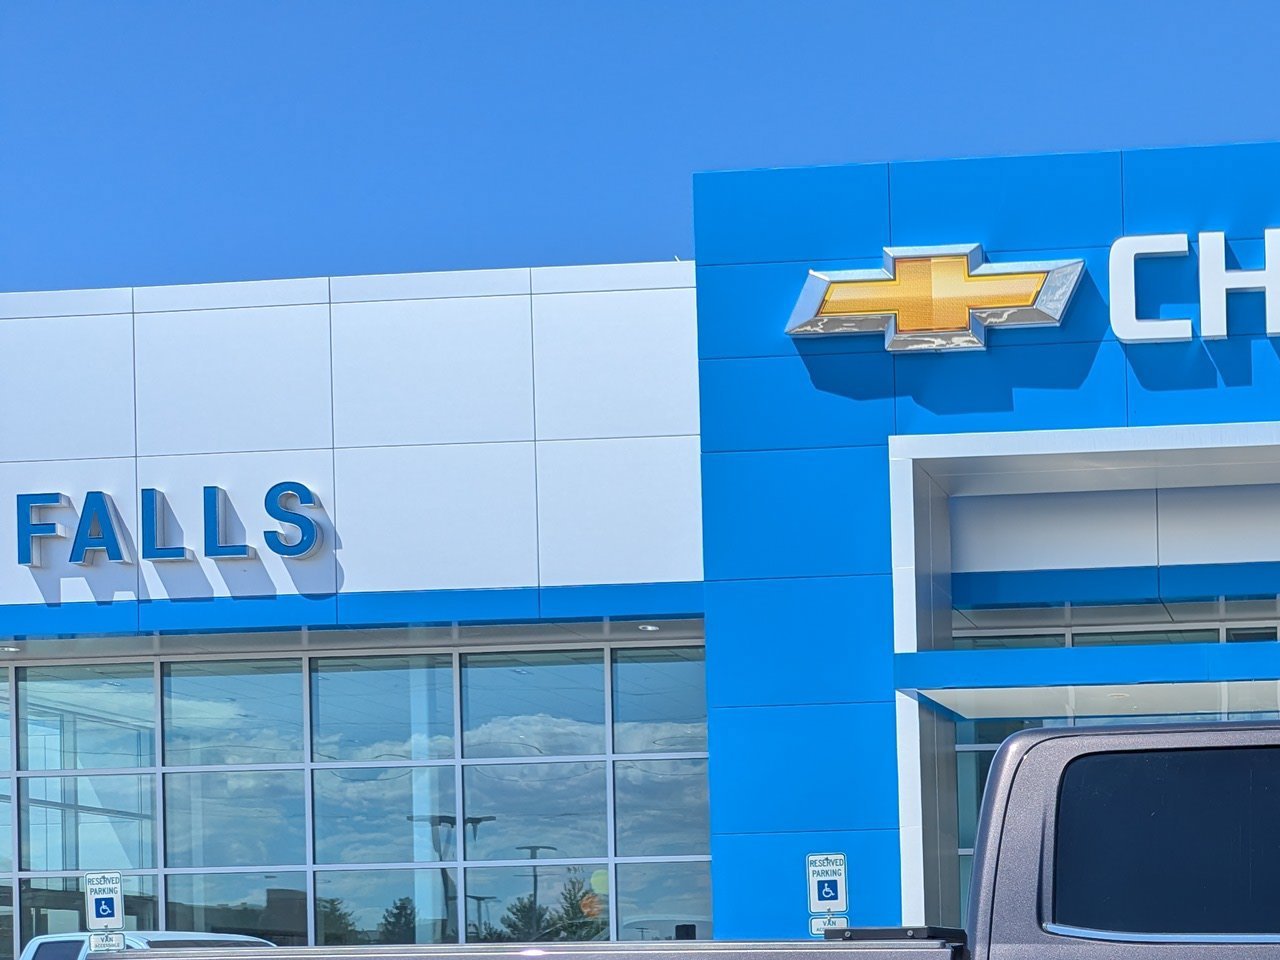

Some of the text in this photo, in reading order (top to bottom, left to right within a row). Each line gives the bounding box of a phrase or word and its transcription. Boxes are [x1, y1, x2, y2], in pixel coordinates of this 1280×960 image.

[17, 481, 323, 567] FALLS
[810, 859, 844, 867] RESERVED
[812, 869, 842, 877] PARKING
[88, 876, 119, 885] RESERVED
[90, 887, 118, 895] PARKING
